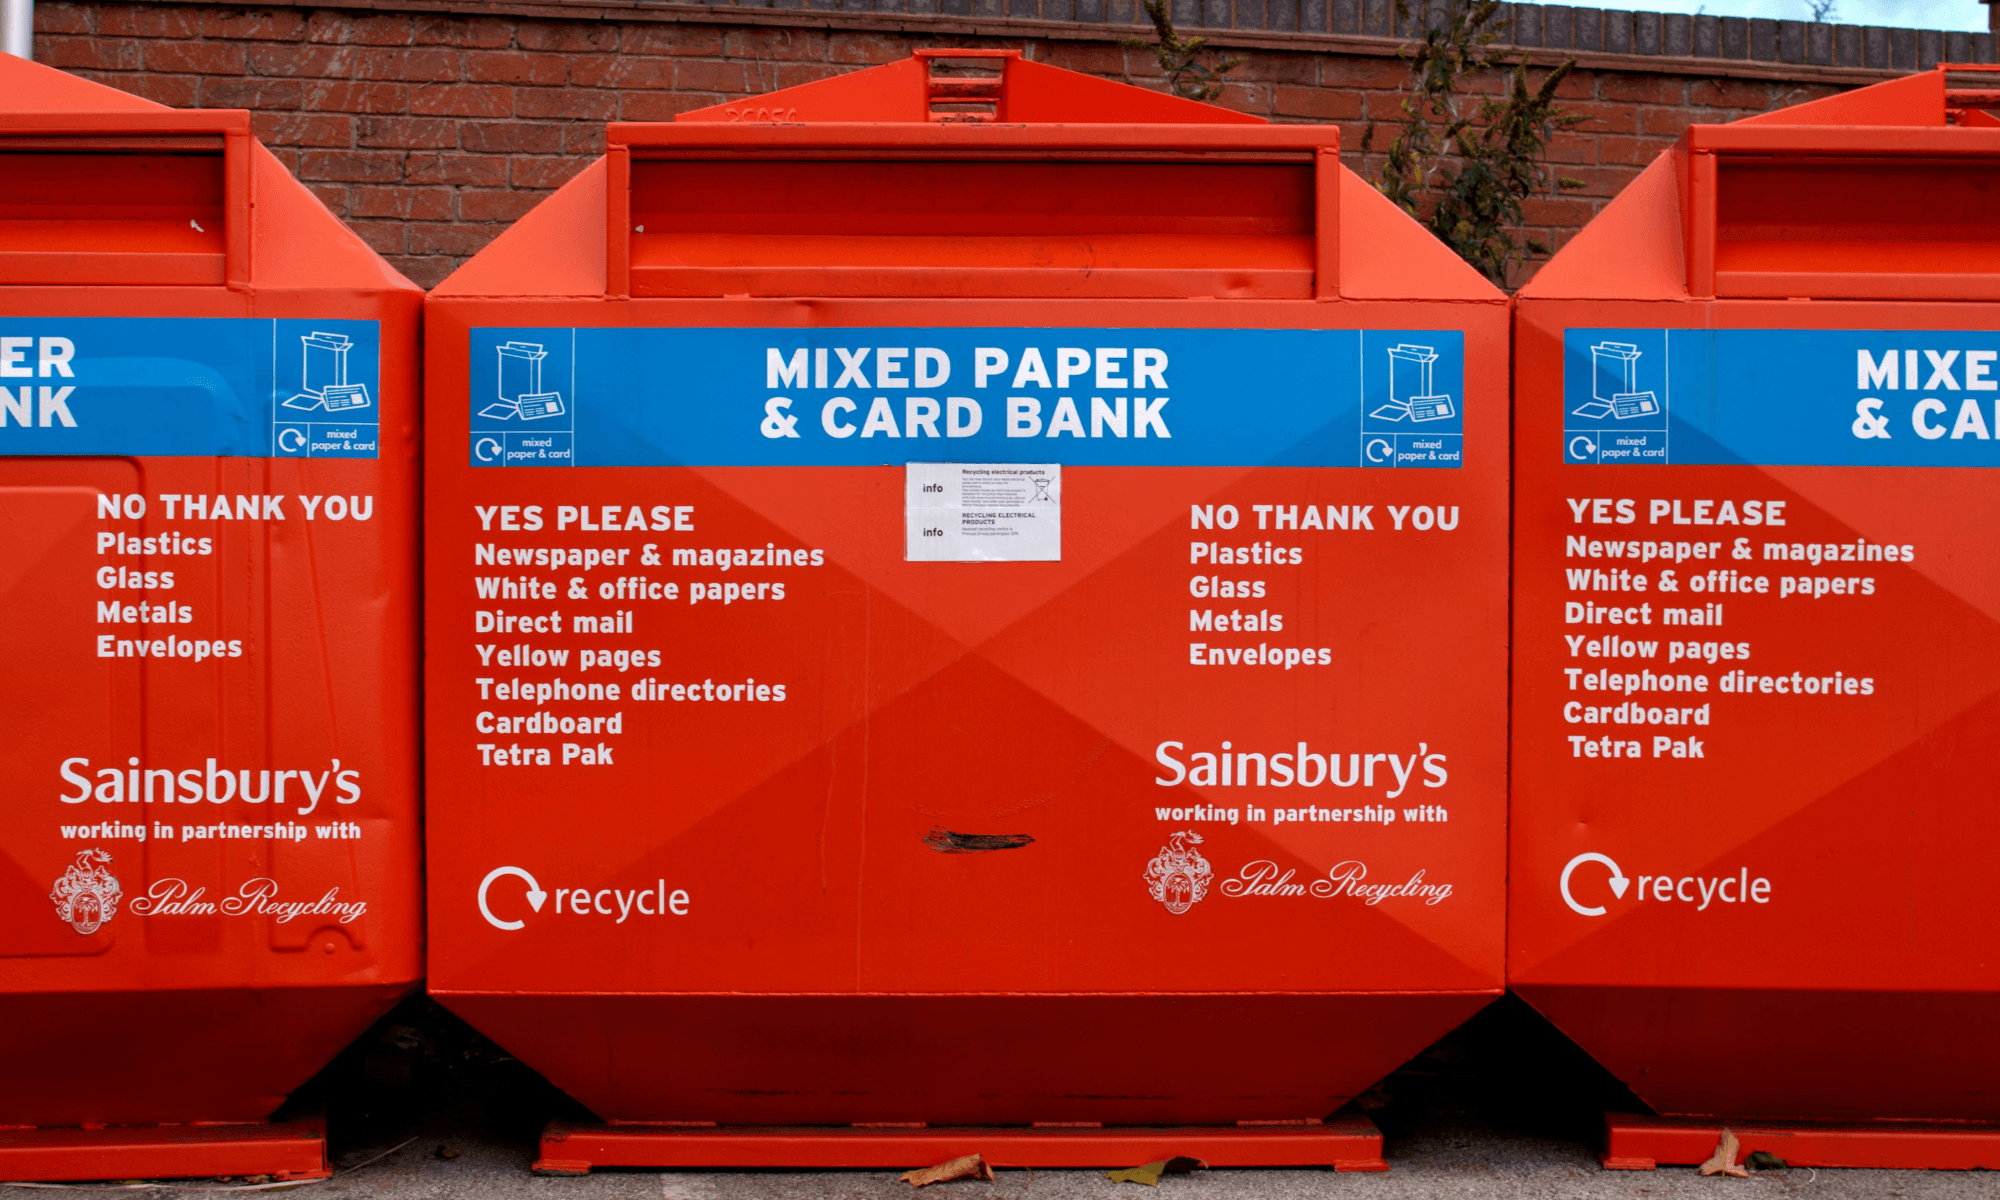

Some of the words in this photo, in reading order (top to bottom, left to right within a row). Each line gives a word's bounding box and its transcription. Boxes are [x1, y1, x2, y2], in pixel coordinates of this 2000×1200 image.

[0, 337, 74, 377] ER
[767, 348, 950, 388] MIXED
[975, 348, 1168, 388] PAPER
[1858, 350, 1997, 390] MIXE
[0, 386, 77, 427] NK
[761, 397, 800, 438] &
[822, 397, 982, 438] CARD
[1007, 397, 1171, 438] BANK
[1852, 398, 1891, 439] &
[1912, 398, 2000, 439] CA
[311, 443, 341, 451] paper
[343, 440, 351, 450] &
[353, 441, 375, 450] card
[327, 429, 358, 437] mixed
[522, 437, 551, 447] mixed
[1413, 439, 1442, 449] mixed
[1616, 436, 1646, 445] mixed
[507, 452, 536, 460] paper
[538, 449, 546, 458] &
[548, 449, 570, 458] card
[1398, 453, 1427, 461] paper
[1429, 451, 1436, 460] &
[1438, 451, 1459, 460] card
[1602, 450, 1630, 458] paper
[1633, 447, 1640, 456] &
[1643, 448, 1664, 456] card
[923, 483, 943, 492] info
[98, 494, 146, 519] NO
[160, 494, 285, 520] THANK
[299, 495, 373, 520] YOU
[475, 506, 543, 531] YES
[558, 506, 694, 531] PLEASE
[1191, 505, 1239, 529] NO
[1253, 505, 1374, 530] THANK
[1387, 506, 1459, 530] YOU
[1567, 499, 1635, 524] YES
[1650, 500, 1785, 525] PLEASE
[97, 531, 212, 555] Plastics
[923, 527, 943, 536] info
[476, 544, 630, 570] Newspaper
[641, 544, 661, 565] &
[673, 543, 823, 571] magazines
[1191, 541, 1302, 564] Plastics
[1567, 536, 1721, 563] Newspaper
[1732, 538, 1752, 559] &
[1764, 538, 1914, 565] magazines
[97, 566, 174, 589] Glass
[1190, 576, 1265, 598] Glass
[1566, 568, 1647, 591] White
[1659, 570, 1679, 591] &
[1690, 570, 1769, 593] office
[1781, 577, 1874, 599] papers
[475, 576, 556, 599] White
[568, 577, 588, 599] &
[599, 577, 678, 599] office
[691, 583, 785, 605] papers
[97, 601, 192, 623] Metals
[476, 610, 561, 633] Direct
[574, 610, 632, 633] mail
[1190, 609, 1283, 631] Metals
[1566, 602, 1651, 624] Direct
[1664, 603, 1722, 625] mail
[98, 635, 242, 662] Envelopes
[476, 644, 569, 666] Yellow
[581, 650, 661, 672] pages
[1190, 643, 1331, 670] Envelopes
[1565, 635, 1658, 657] Yellow
[1669, 642, 1750, 664] pages
[476, 678, 620, 705] Telephone
[632, 678, 786, 701] directories
[1564, 668, 1708, 695] Telephone
[1720, 670, 1874, 695] directories
[476, 712, 621, 734] Cardboard
[1564, 701, 1709, 725] Cardboard
[477, 744, 550, 766] Tetra
[563, 743, 613, 765] Pak
[1568, 736, 1641, 758] Tetra
[1654, 736, 1704, 758] Pak
[1156, 741, 1447, 798] Sainsbury's
[61, 757, 360, 815] Sainsbury's
[1155, 804, 1238, 825] working
[1247, 804, 1265, 821] in
[1274, 805, 1395, 825] partnership
[1403, 805, 1447, 822] with
[61, 821, 146, 842] working
[155, 821, 173, 838] in
[182, 821, 307, 842] partnership
[315, 821, 361, 839] with
[1221, 860, 1306, 896] Palm
[1310, 861, 1452, 905] Recycling
[1639, 867, 1770, 911] recycle
[130, 878, 216, 915] Palm
[221, 878, 366, 923] Recycling
[556, 879, 689, 923] recycle
